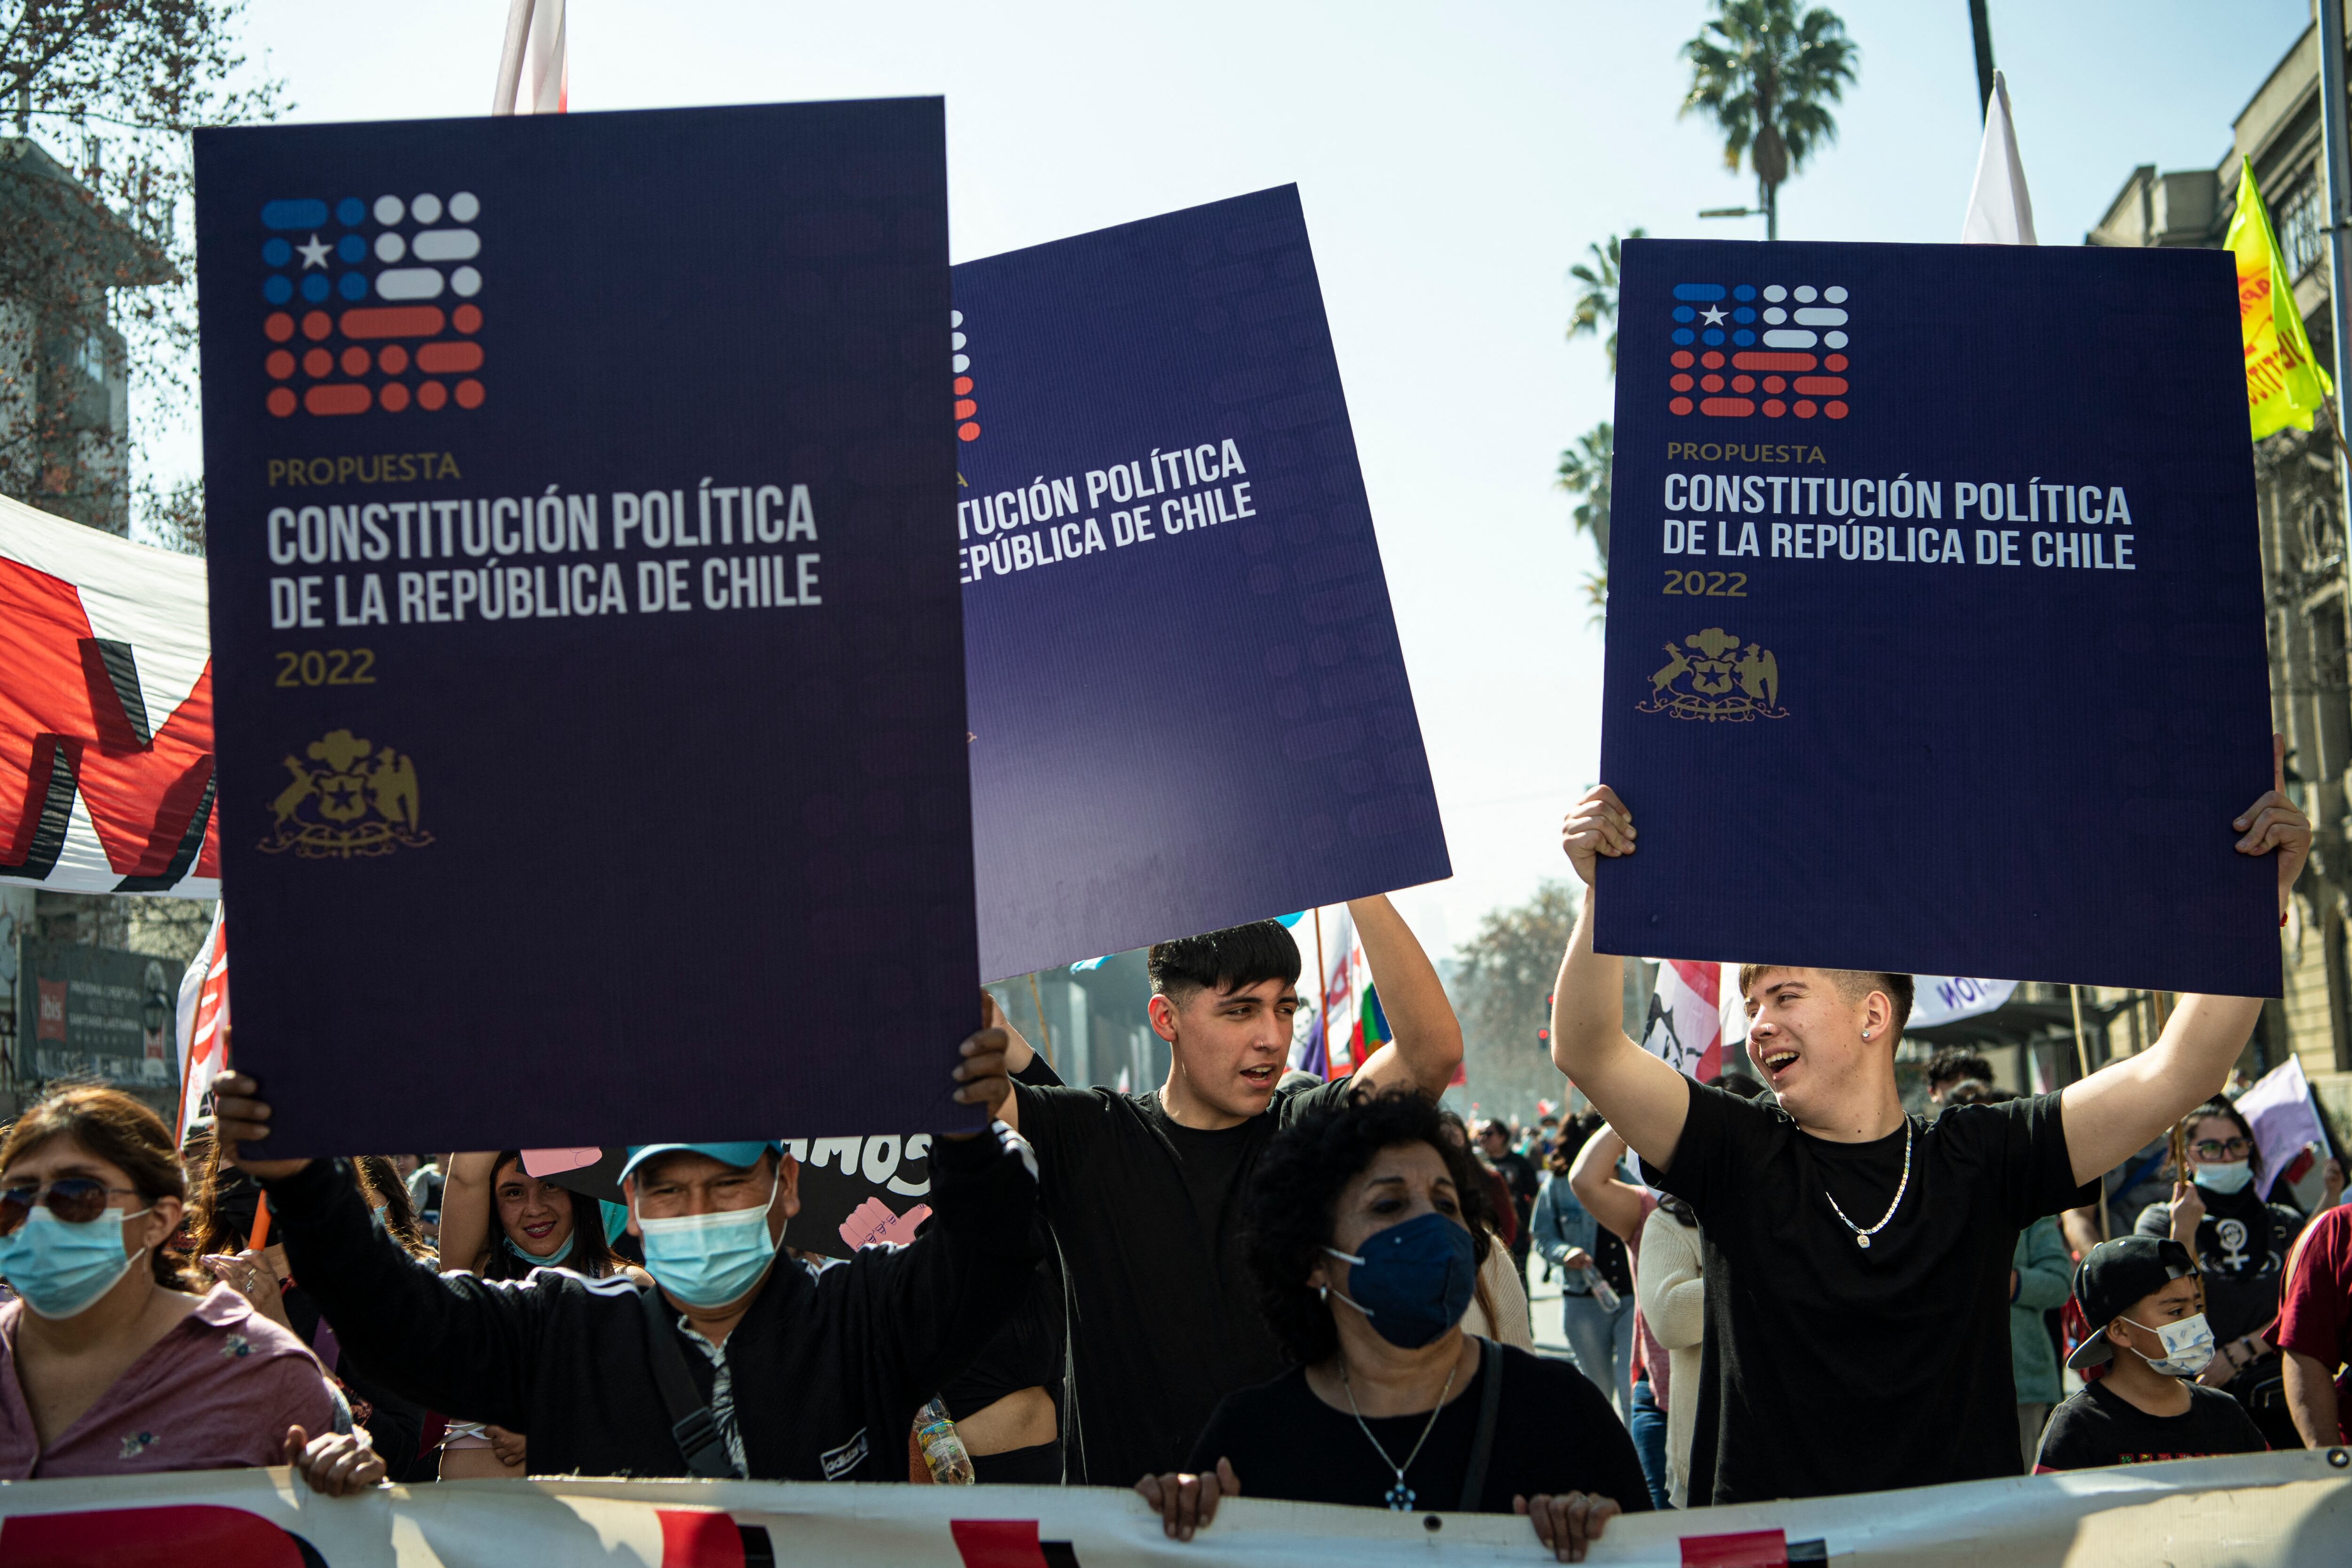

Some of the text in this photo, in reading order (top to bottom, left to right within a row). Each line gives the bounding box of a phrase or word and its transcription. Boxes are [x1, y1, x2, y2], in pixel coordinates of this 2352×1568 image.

[268, 452, 461, 487] PROPUESTA
[1085, 438, 1246, 509] POLÍTICA
[1667, 441, 1827, 464] PROPUESTA
[268, 477, 818, 565] CONSTITUCIÓN POLÍTICA
[1112, 505, 1156, 546] DE
[1161, 481, 1256, 534] CHILE
[1664, 472, 2132, 525] CONSTITUCIÓN POLÍTICA
[1663, 518, 2136, 570] DE LA REPÚBLICA DE CHILE
[270, 553, 822, 629] DE LA REPÚBLICA DE CHILE
[1662, 569, 1748, 597] 2022
[276, 648, 376, 687] 2022
[40, 995, 63, 1021] ibis
[826, 1445, 859, 1472] adidas
